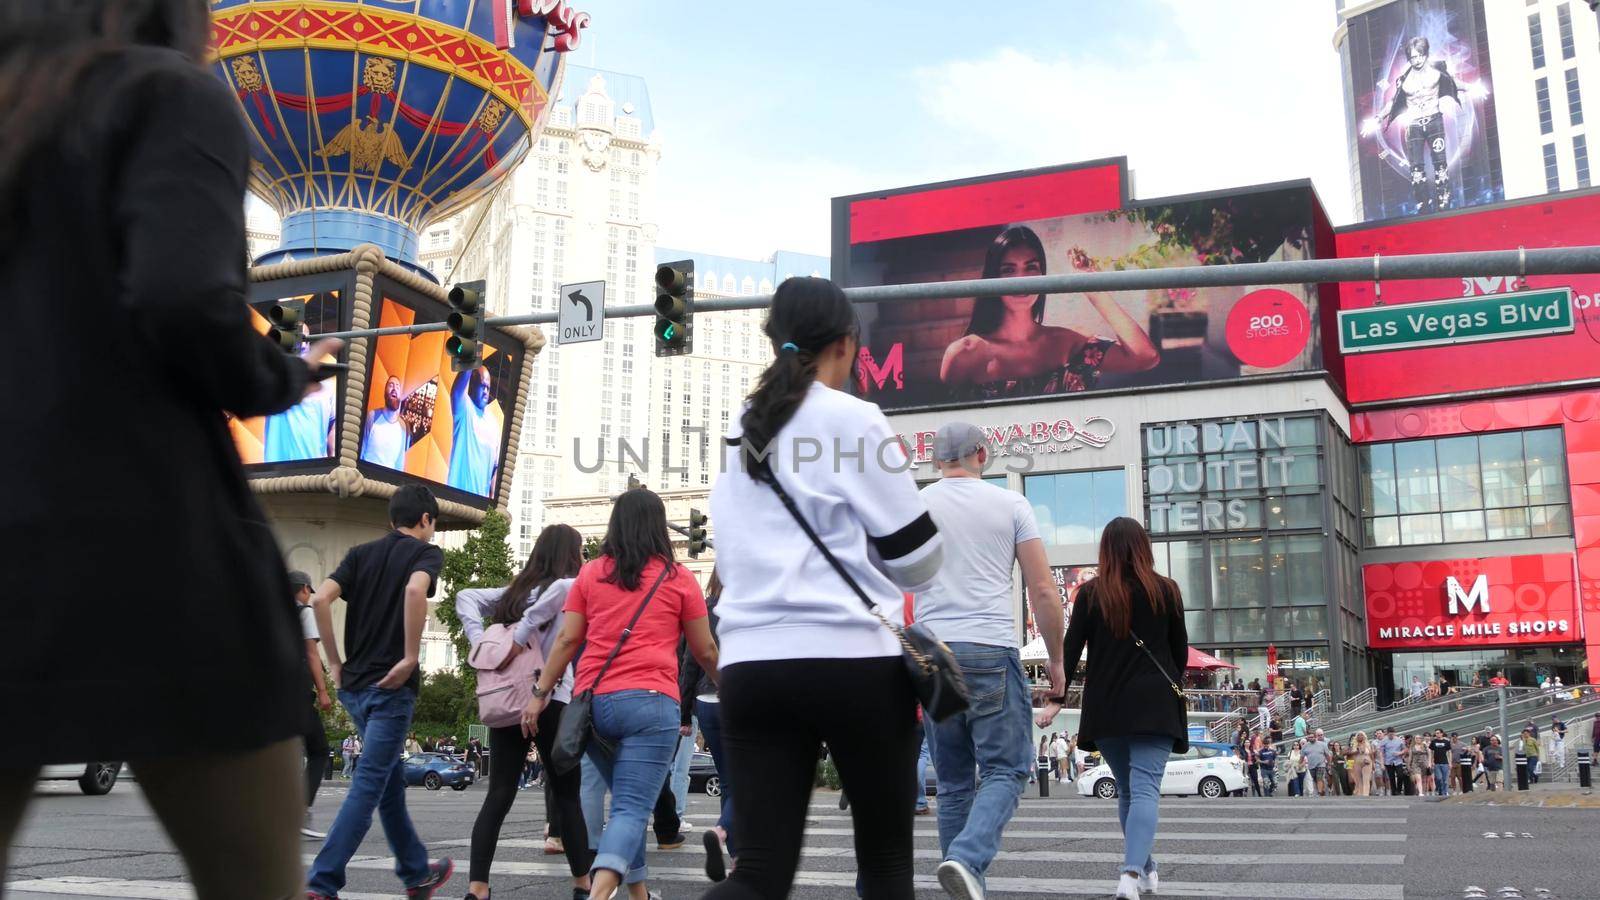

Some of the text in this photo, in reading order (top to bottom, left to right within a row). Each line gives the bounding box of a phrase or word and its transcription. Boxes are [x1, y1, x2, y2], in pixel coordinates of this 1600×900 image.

[564, 324, 596, 339] ONLY
[1246, 325, 1289, 339] STORES
[1250, 314, 1284, 329] 200
[1351, 299, 1560, 340] Las Vegas Blvd
[858, 342, 903, 392] M
[1146, 417, 1287, 456] URBAN
[1149, 456, 1295, 494] OUTFIT
[1149, 498, 1248, 533] TERS
[1446, 574, 1490, 614] M
[1380, 619, 1569, 639] MIRACLE MILE SHOPS
